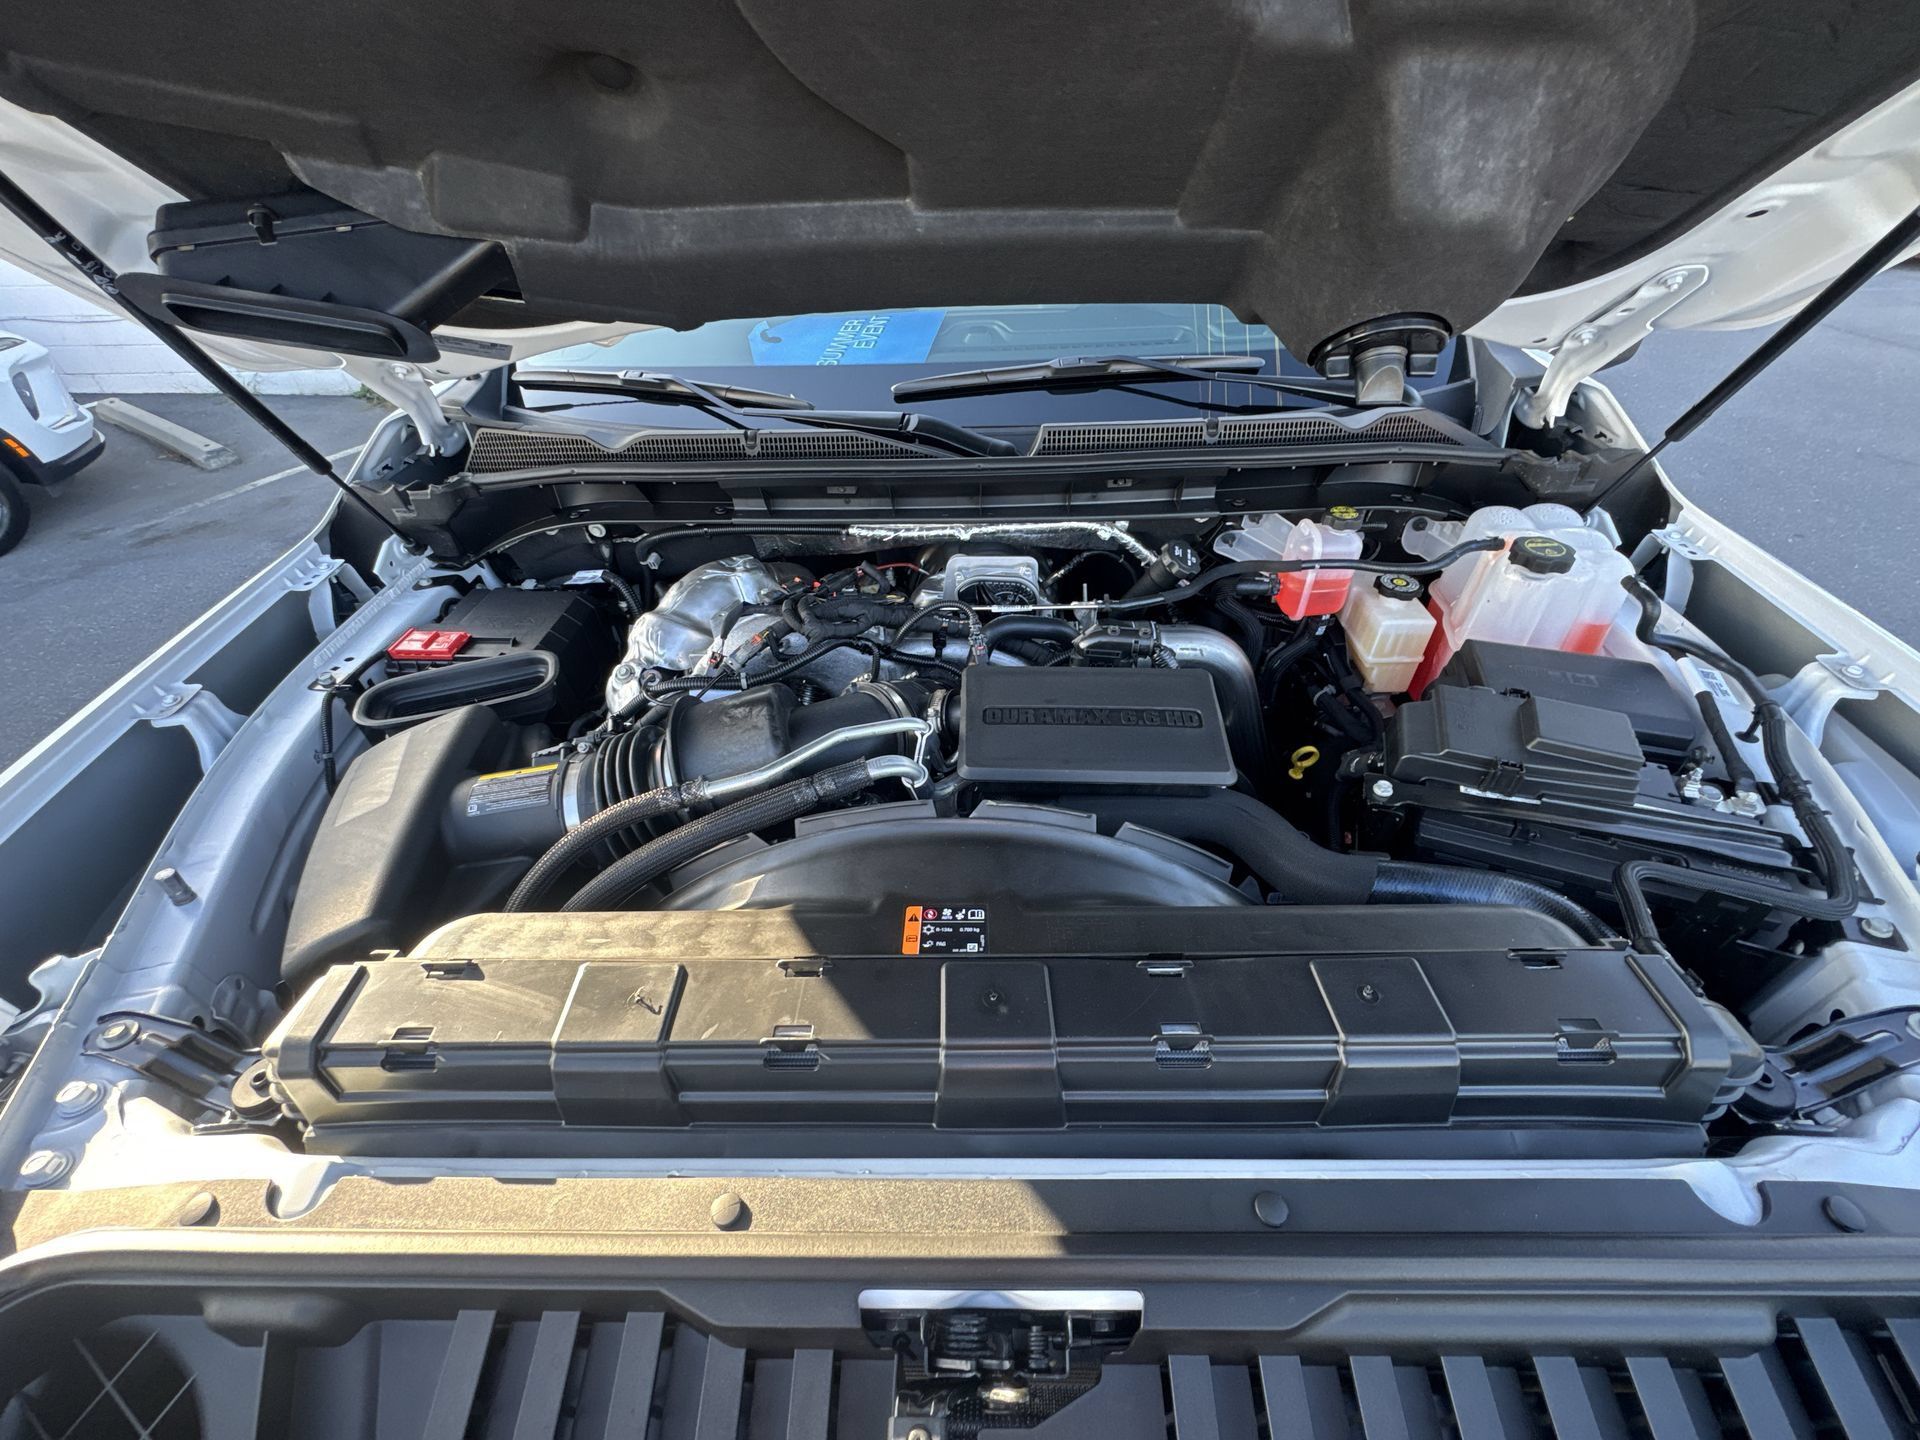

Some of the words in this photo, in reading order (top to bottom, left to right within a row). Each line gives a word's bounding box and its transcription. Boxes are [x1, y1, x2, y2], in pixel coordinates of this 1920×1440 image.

[852, 315, 891, 349] EVENT
[985, 707, 1110, 725] DURAMAX
[1120, 709, 1161, 726] 6.6
[1166, 710, 1200, 728] HD
